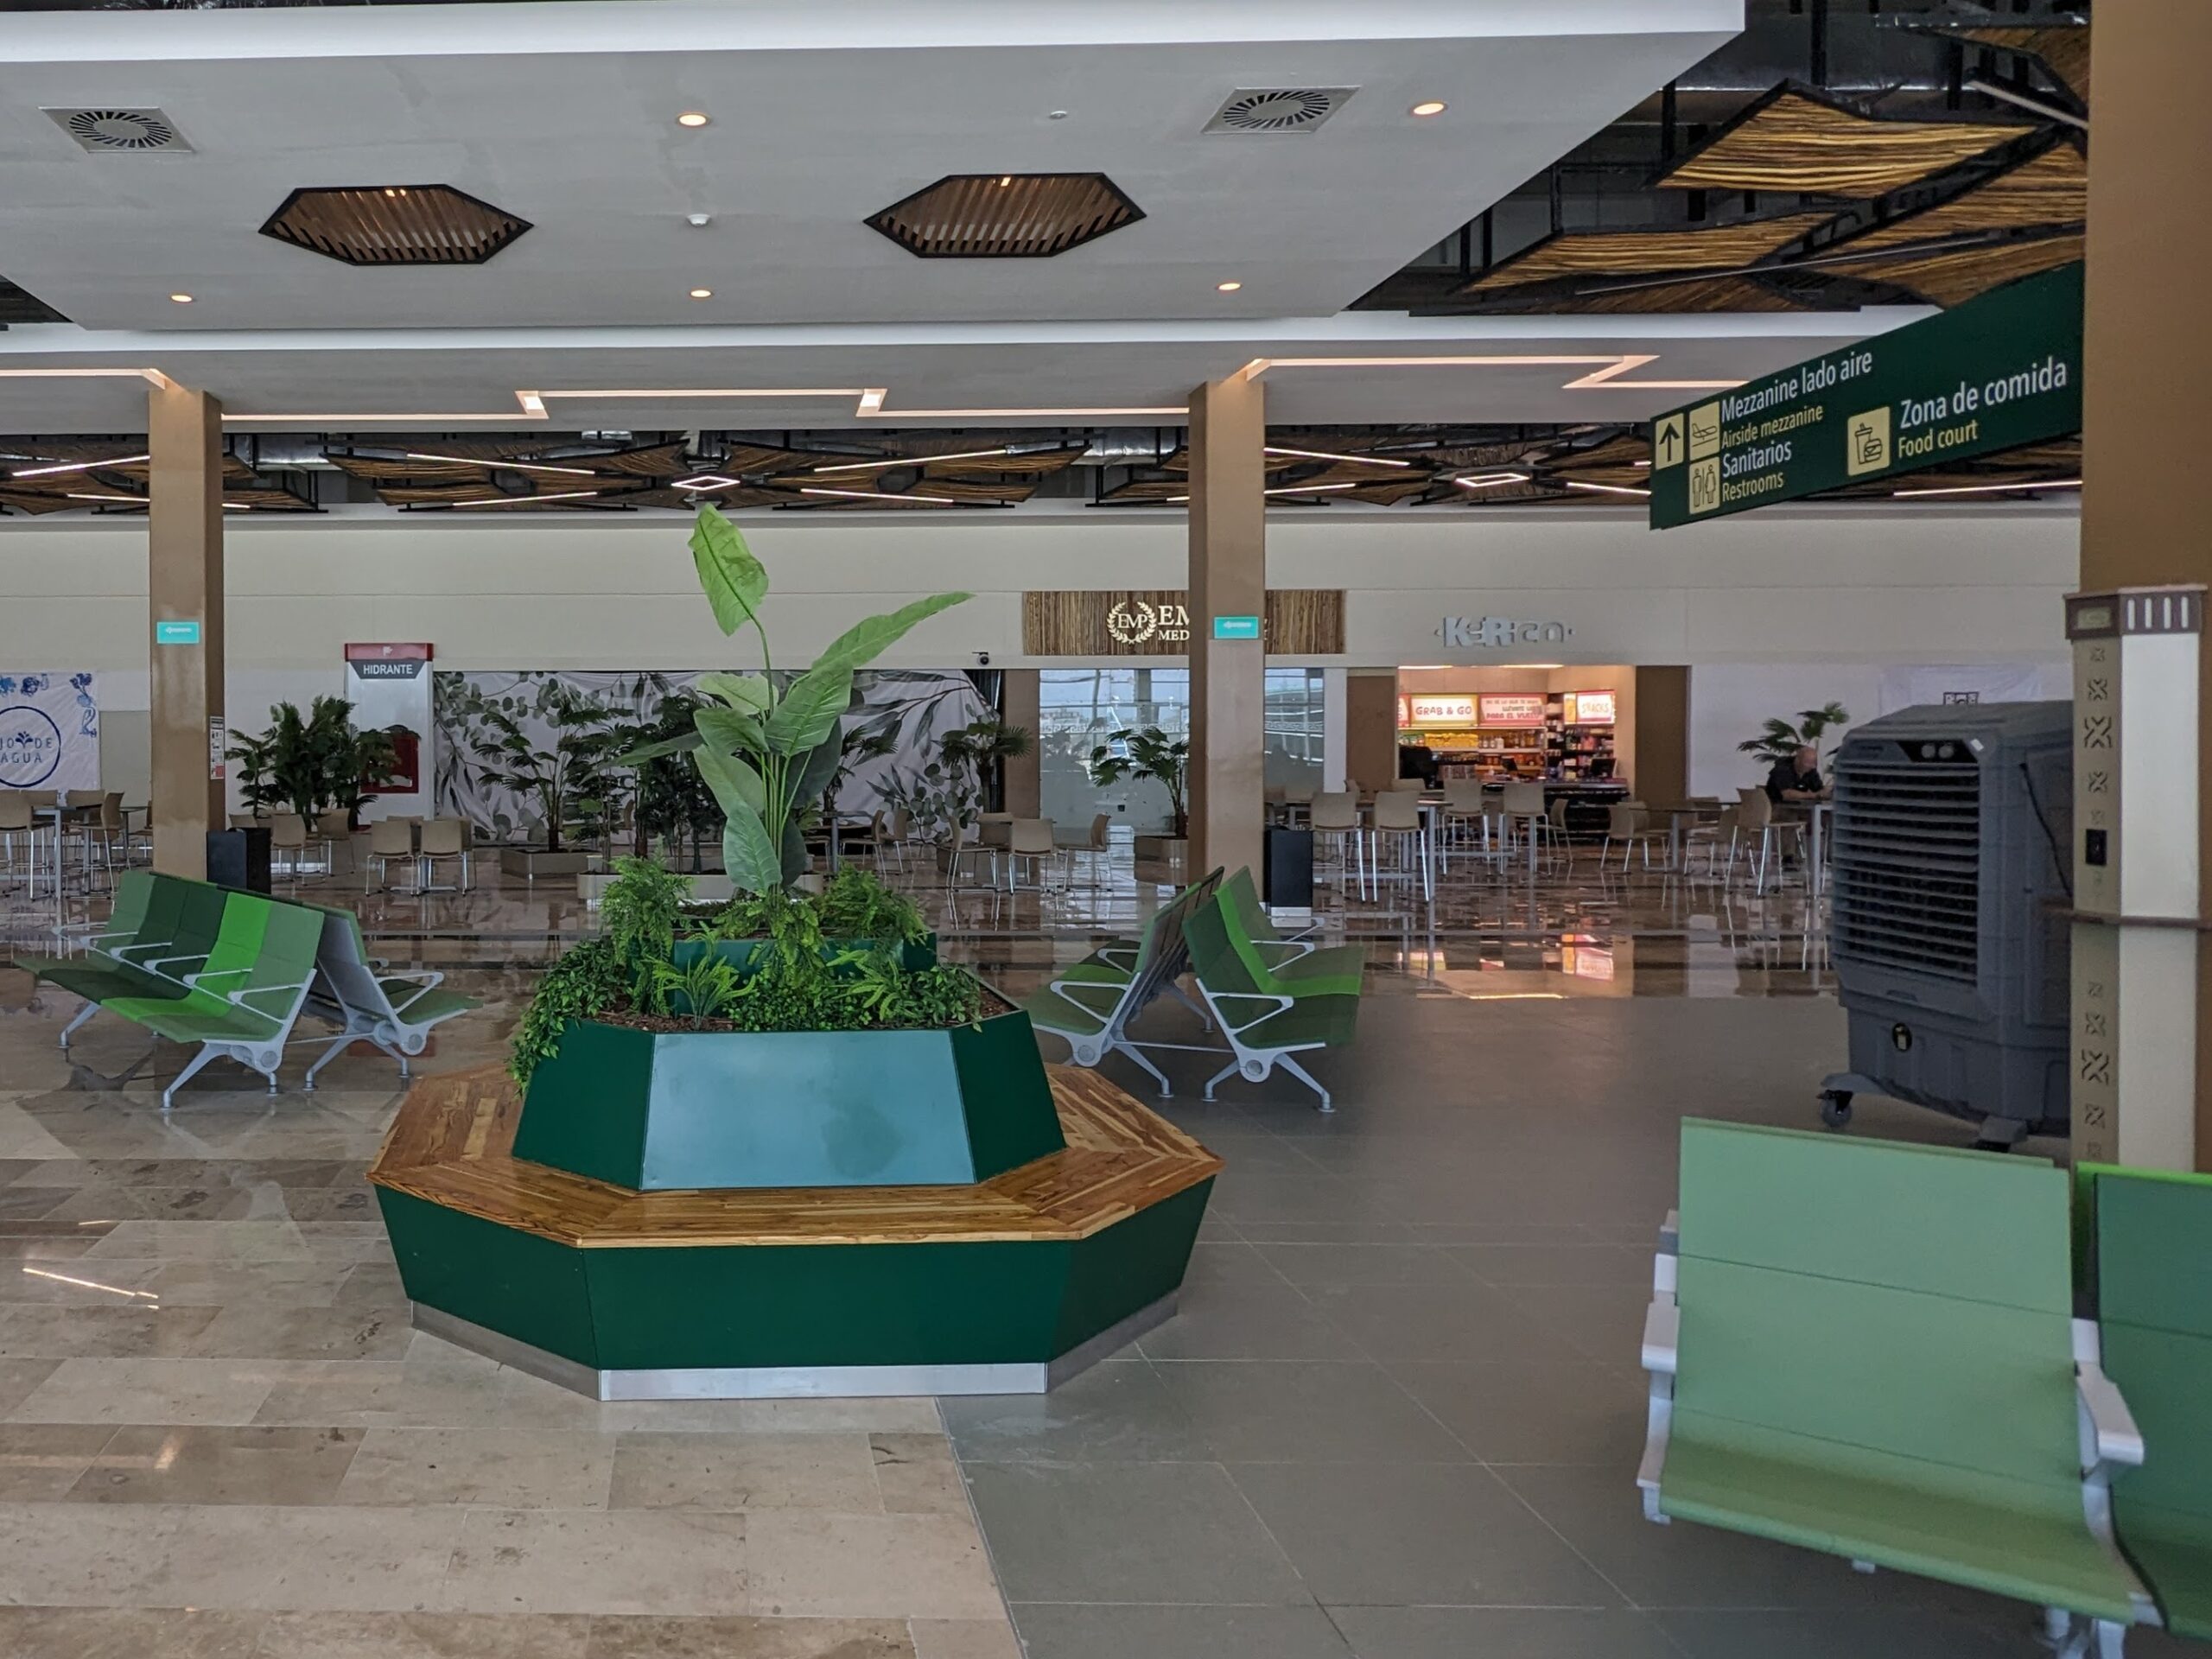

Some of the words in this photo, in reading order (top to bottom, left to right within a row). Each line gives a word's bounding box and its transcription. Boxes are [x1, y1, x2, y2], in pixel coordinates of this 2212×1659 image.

[1721, 378, 1798, 423] Mezzanine
[1802, 359, 1836, 395] lado
[1840, 351, 1872, 381] aire
[1900, 397, 1947, 429] Zona
[1953, 381, 1979, 415] de
[1985, 355, 2067, 406] comida
[1722, 421, 1758, 449] Airside
[1761, 404, 1824, 437] mezzanine
[1898, 428, 1934, 459] Food
[1937, 419, 1979, 448] court
[1722, 440, 1792, 478] Sanitarios
[1722, 472, 1784, 502] Restrooms
[1117, 613, 1147, 629] EMP
[1158, 630, 1190, 641] MED
[363, 664, 413, 675] HIDRANTE
[1415, 706, 1443, 715] GRAB
[1446, 706, 1453, 715] &
[1457, 706, 1472, 715] GO
[0, 737, 15, 750] JO
[35, 738, 52, 749] DE
[1, 752, 42, 764] AGUA
